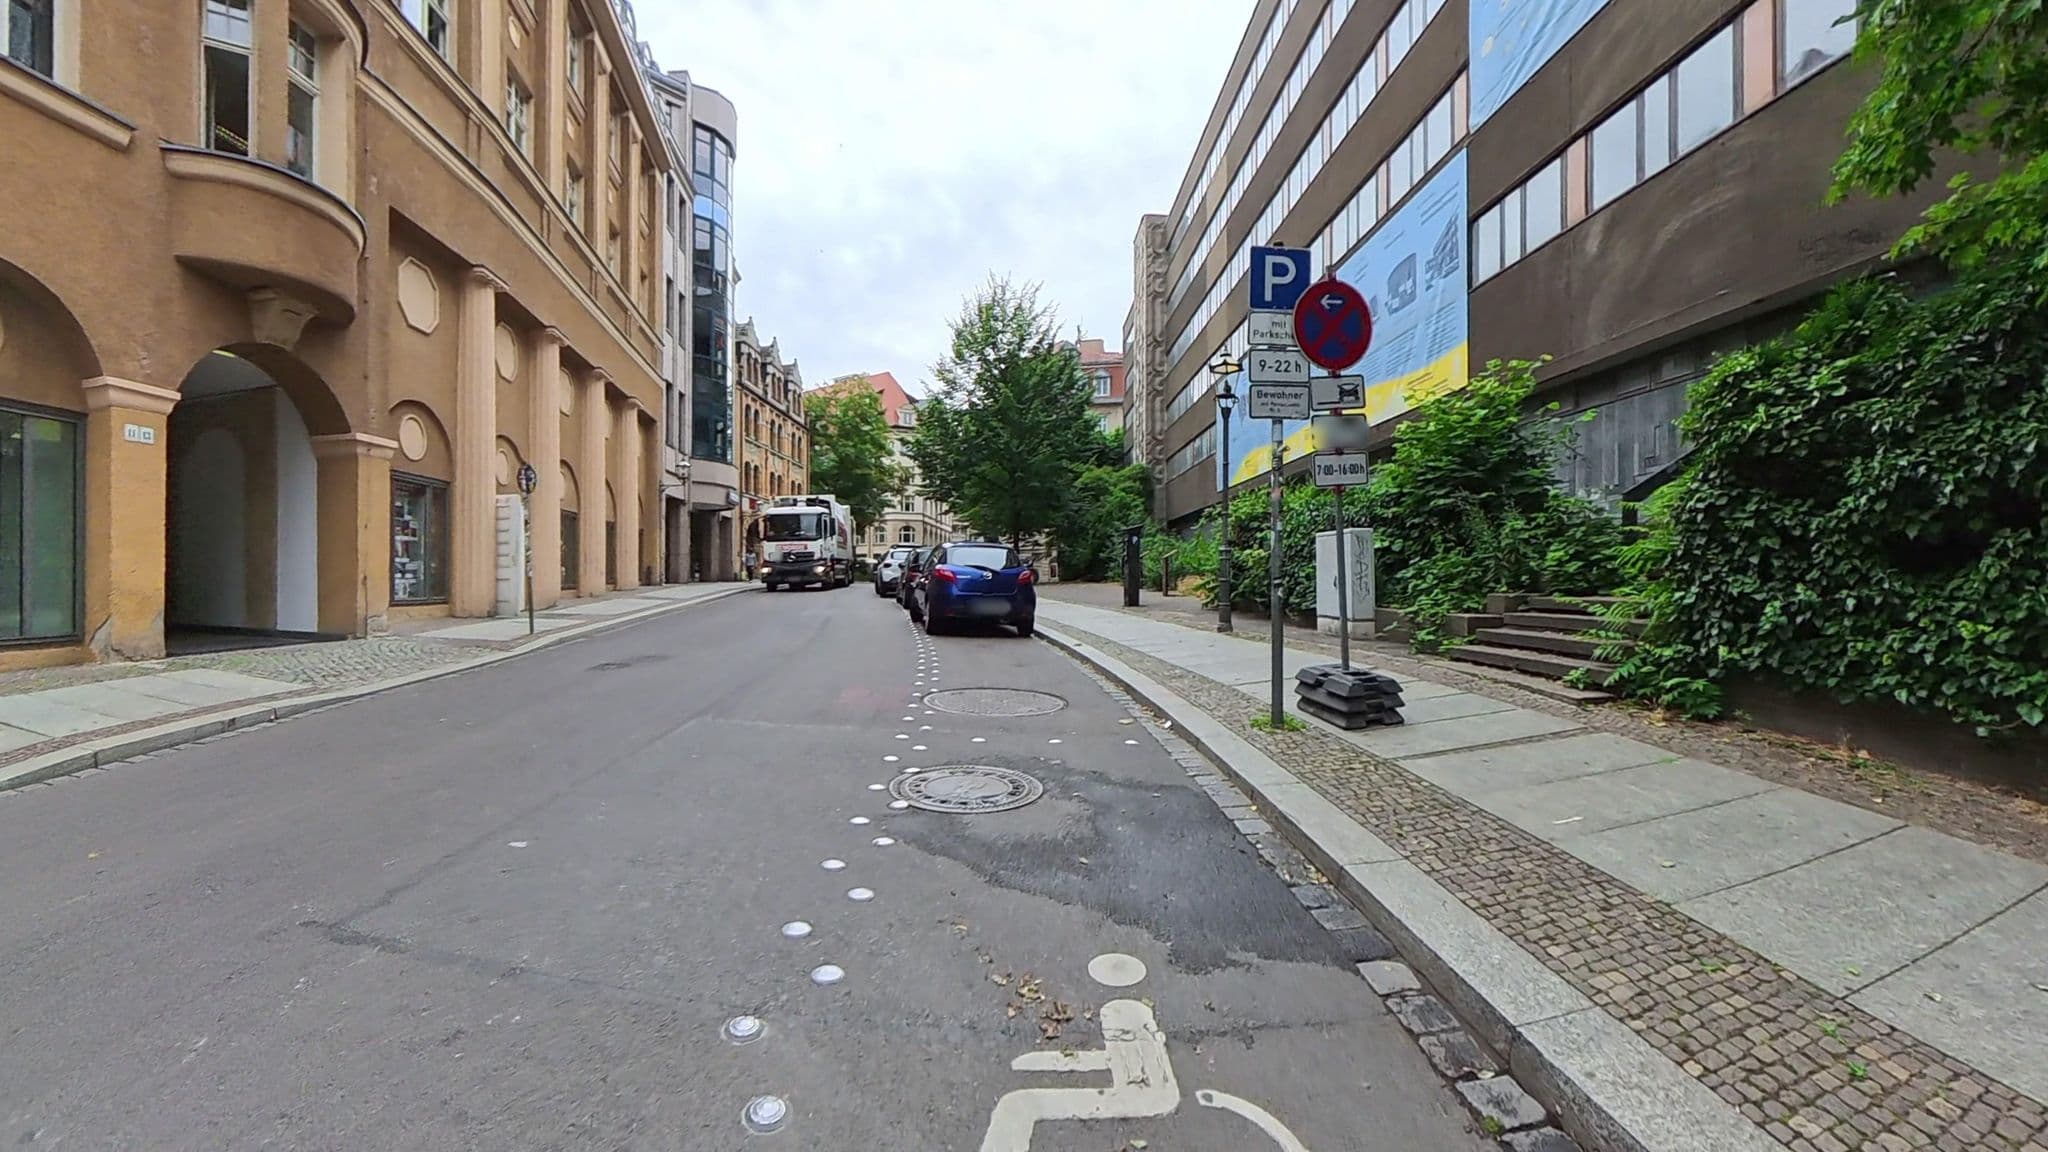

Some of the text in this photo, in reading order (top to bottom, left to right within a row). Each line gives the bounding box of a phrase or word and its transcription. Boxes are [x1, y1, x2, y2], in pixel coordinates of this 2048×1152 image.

[1264, 255, 1297, 302] P
[1271, 320, 1287, 329] mit
[1253, 329, 1294, 340] Parksch
[1259, 359, 1302, 373] 9-22 h
[1257, 389, 1303, 400] Bewohner
